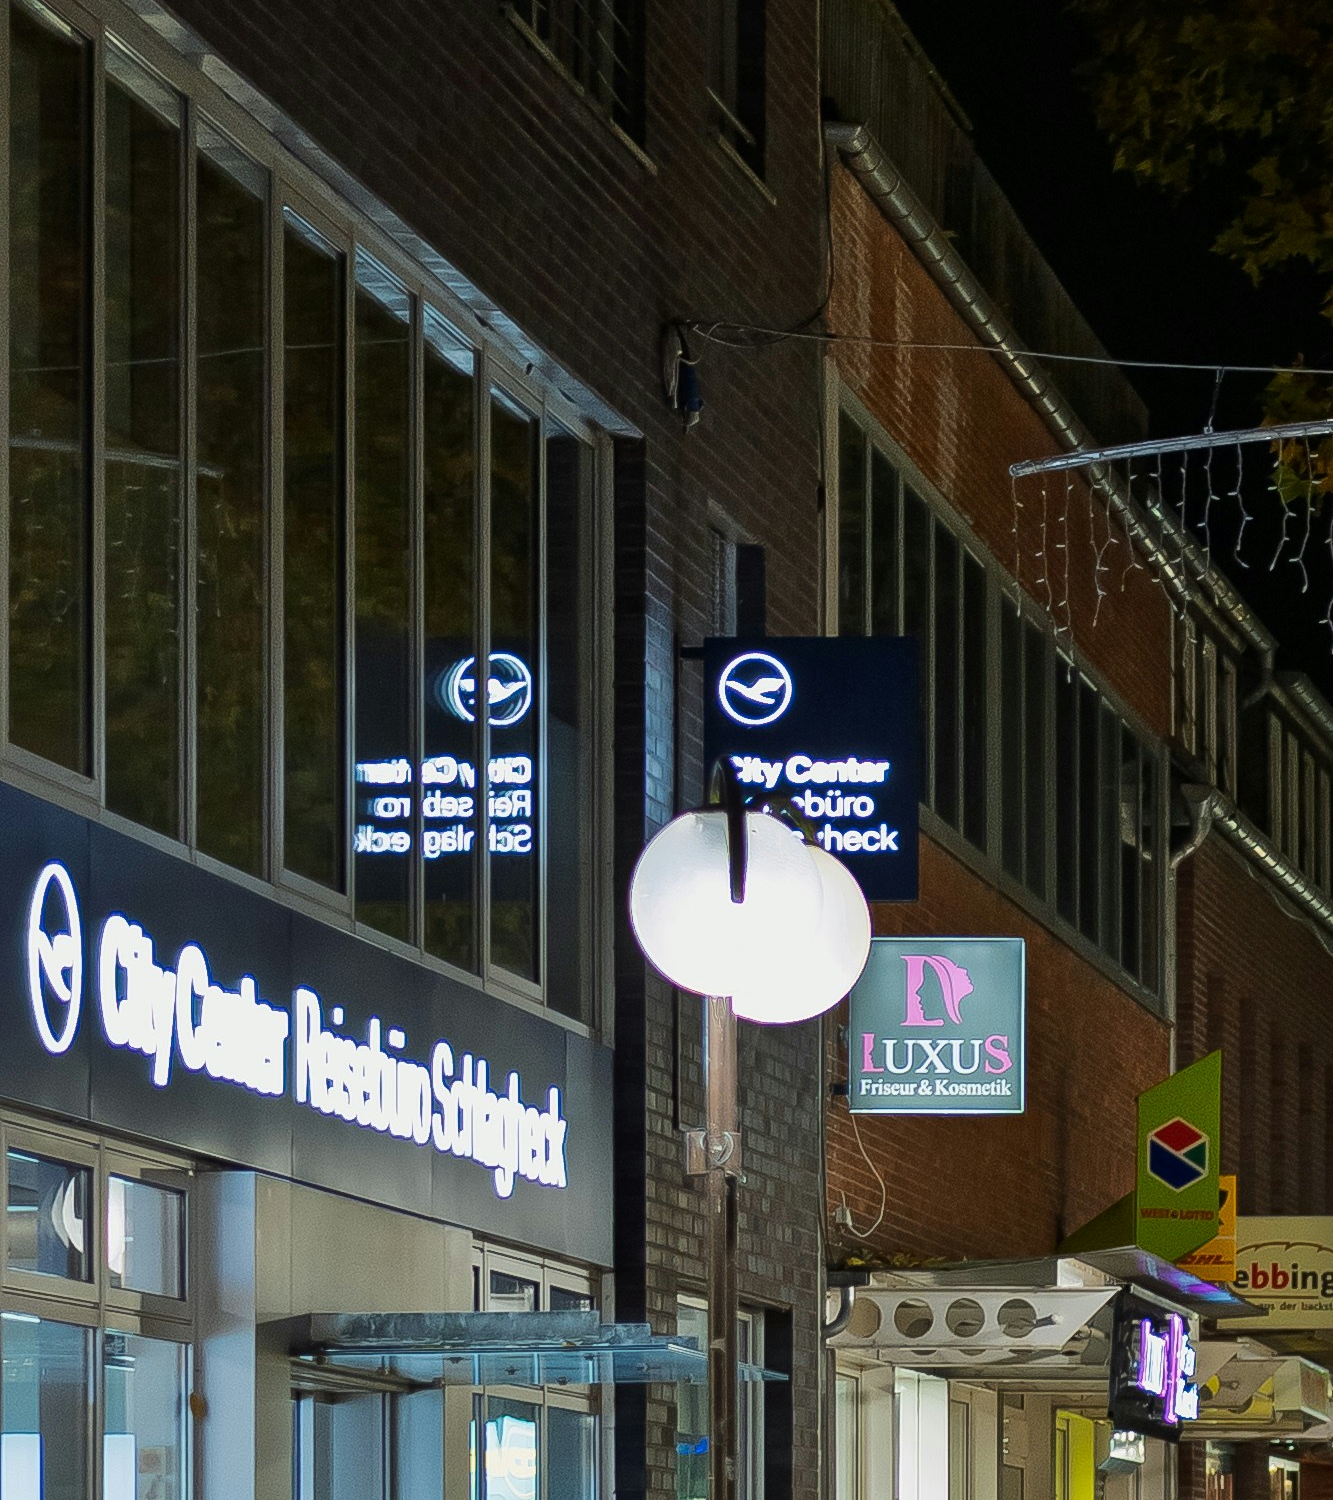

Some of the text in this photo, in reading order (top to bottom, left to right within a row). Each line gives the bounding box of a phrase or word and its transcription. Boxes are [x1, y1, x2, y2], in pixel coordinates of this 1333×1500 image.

[785, 755, 890, 784] Center
[99, 912, 568, 1199] City Center Reisebüro Schlagheck
[861, 1033, 1013, 1074] LUXUS
[860, 1078, 917, 1096] Friseur
[935, 1078, 1012, 1096] Kosmetik
[1184, 1254, 1228, 1265] DHL
[1280, 1302, 1298, 1311] der
